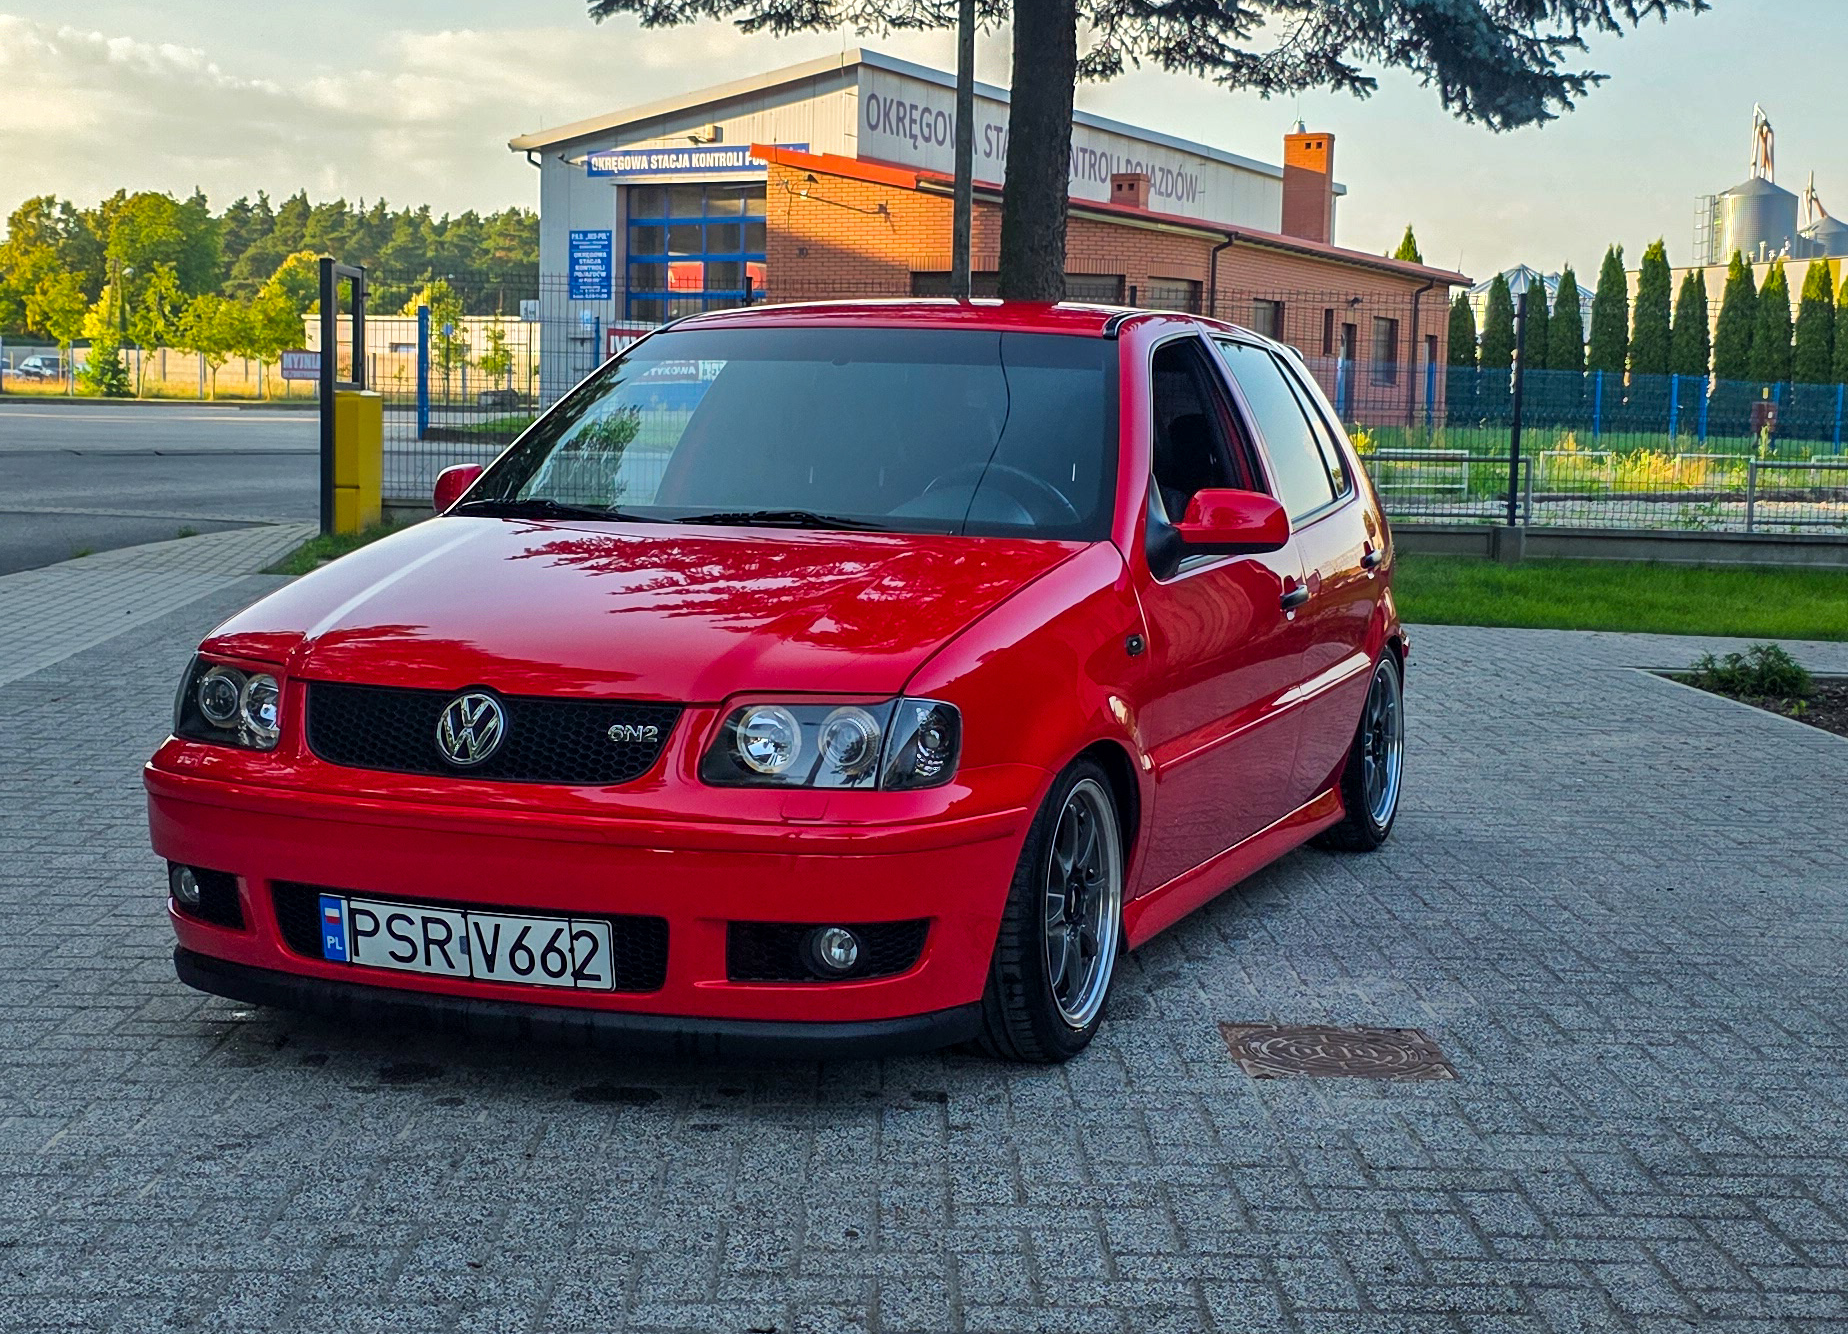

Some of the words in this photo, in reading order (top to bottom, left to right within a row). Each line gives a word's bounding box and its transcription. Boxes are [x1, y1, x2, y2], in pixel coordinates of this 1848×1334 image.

[591, 157, 648, 174] OKRĘGOWA
[650, 154, 690, 169] STACJA
[692, 152, 742, 168] KONTROLI
[607, 724, 659, 744] 6N2
[326, 935, 343, 951] PL
